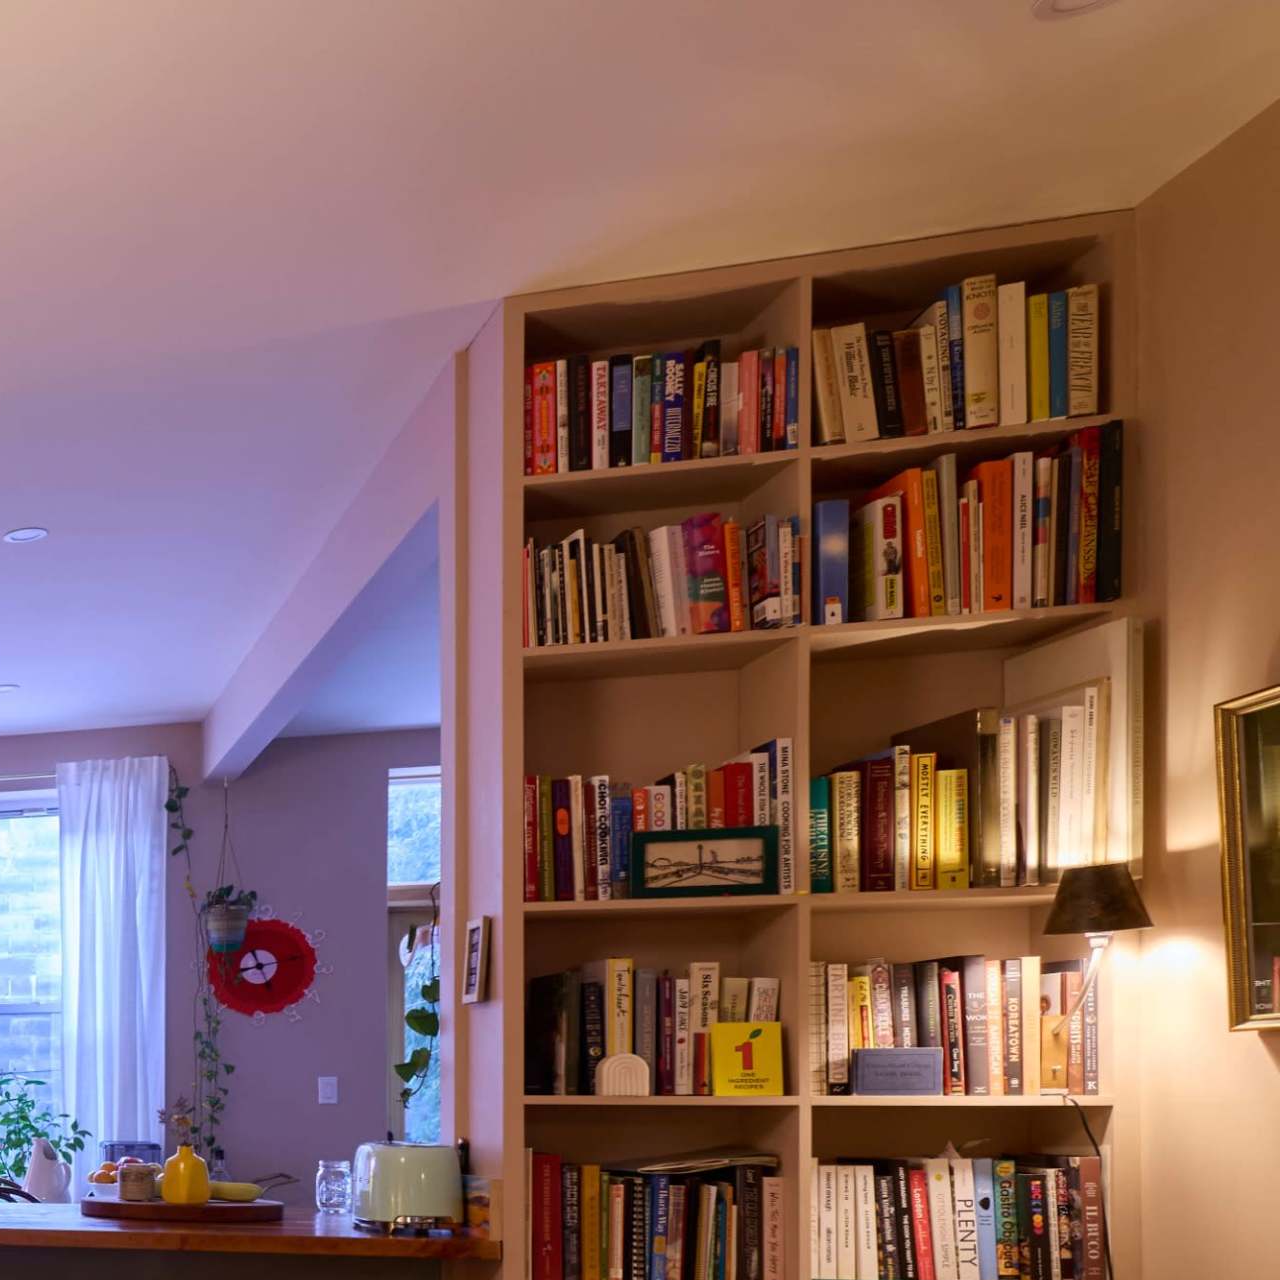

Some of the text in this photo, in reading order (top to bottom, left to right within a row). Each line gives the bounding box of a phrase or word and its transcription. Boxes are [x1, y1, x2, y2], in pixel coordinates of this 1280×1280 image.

[939, 312, 948, 362] VOYAGING
[1071, 312, 1093, 338] YEAR
[844, 342, 857, 373] William
[1071, 350, 1093, 392] FRENCH
[597, 365, 607, 431] TAKEAWAY
[665, 360, 675, 402] ROONEY
[675, 363, 684, 396] SALLY
[706, 392, 717, 408] FIRE
[665, 407, 682, 453] INTERMEZZO
[781, 770, 789, 795] STONE
[636, 814, 645, 831] THE
[653, 793, 665, 827] GOOD
[782, 801, 790, 837] COOKING
[920, 763, 929, 862] MOSTLY EVERYTHING
[598, 815, 608, 865] COOKING
[816, 814, 829, 875] THE CUISINE
[783, 857, 791, 889] ARTISTS
[677, 988, 688, 1009] JAM
[700, 974, 712, 1028] Six Seasons
[966, 1014, 988, 1022] WOK
[831, 965, 845, 1081] TARTINE BREAD
[1008, 998, 1018, 1062] KOREATOWN
[734, 1040, 754, 1070] 1
[913, 1188, 923, 1219] London
[656, 1217, 667, 1233] Way
[957, 1199, 977, 1267] PLENTY
[1000, 1180, 1015, 1269] Gastro Obscura
[1086, 1205, 1099, 1260] IL BUCO
